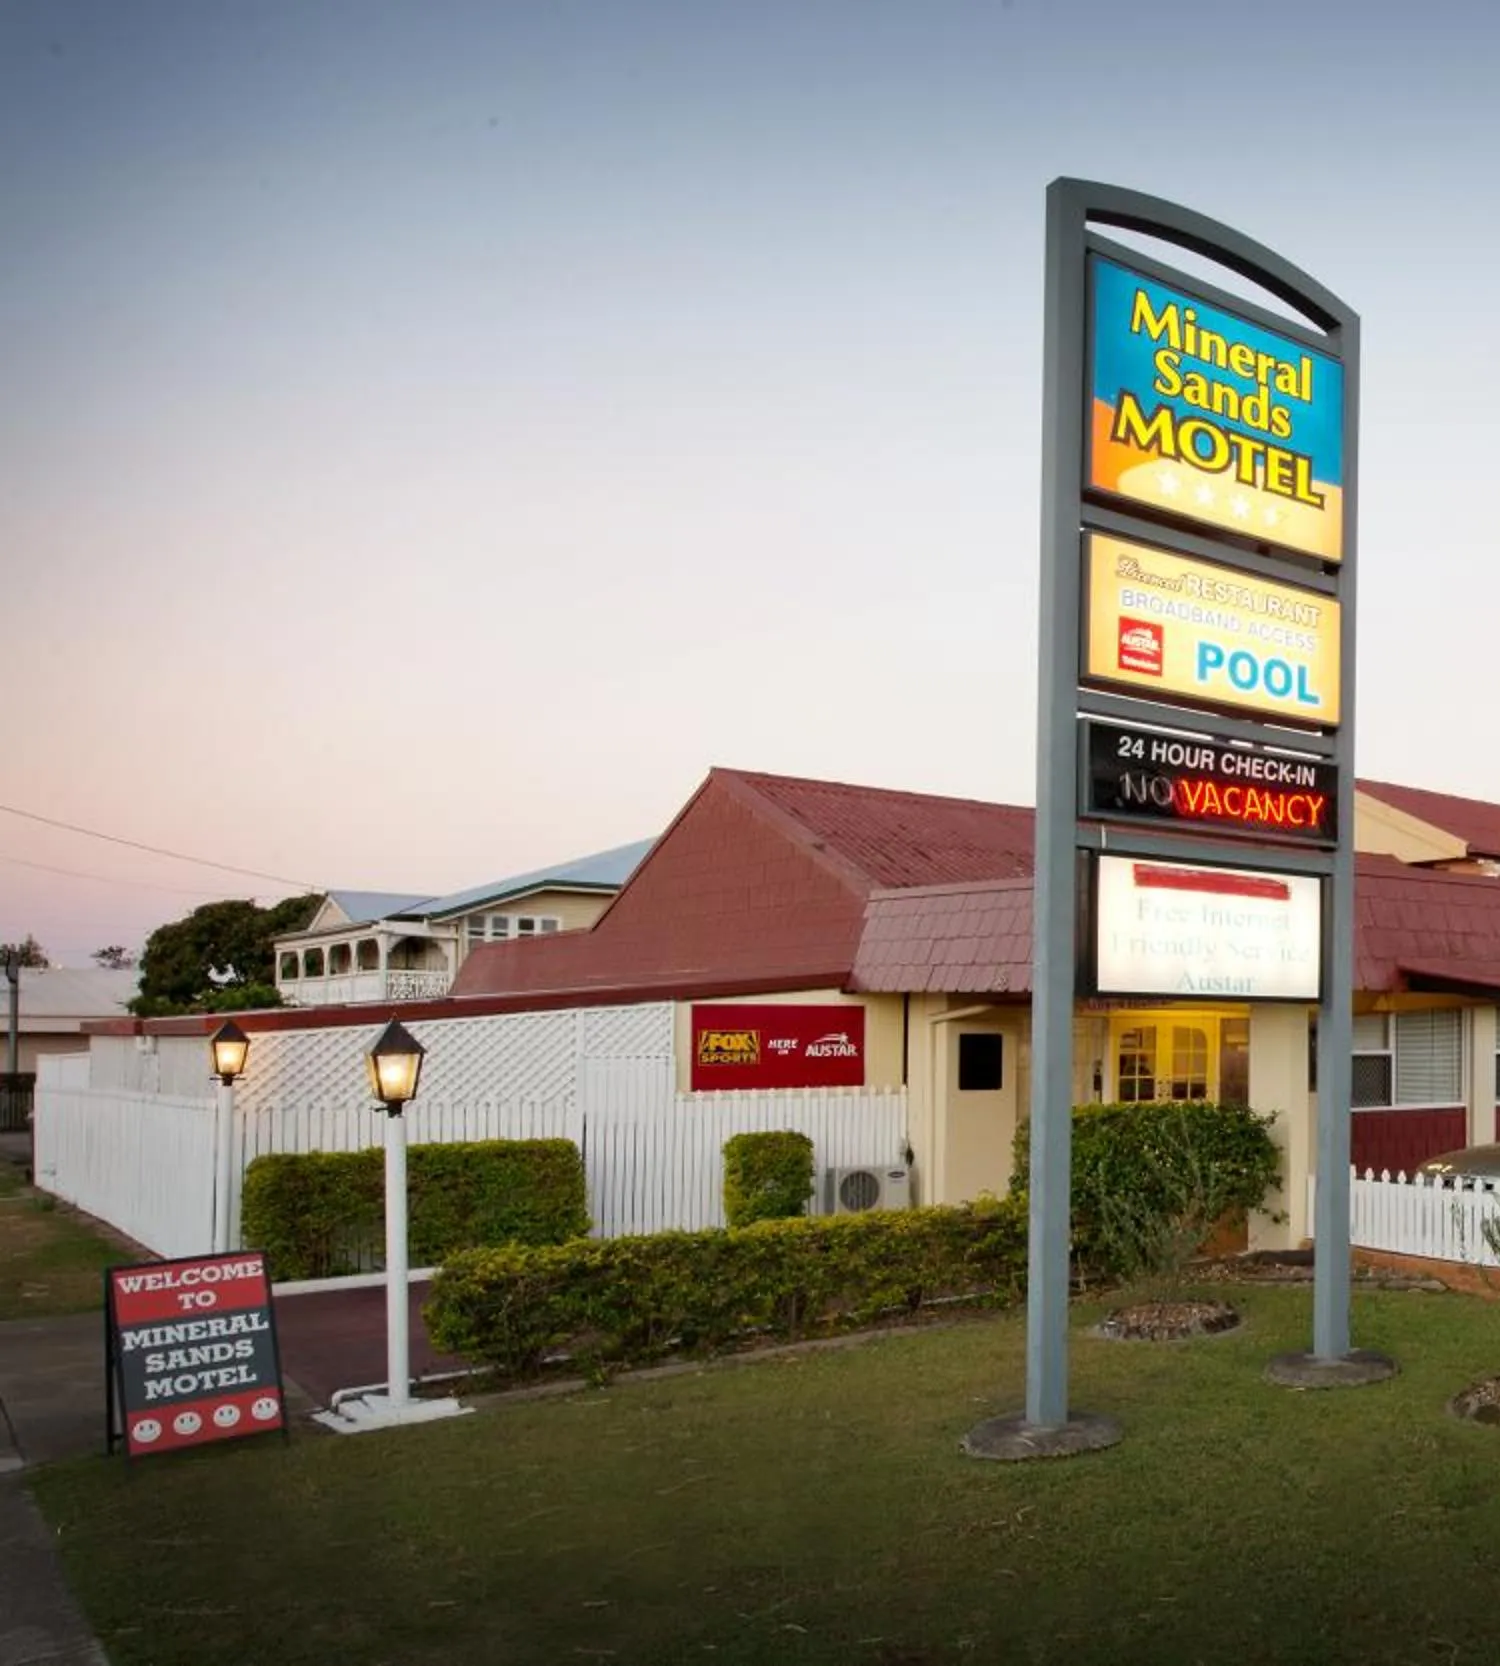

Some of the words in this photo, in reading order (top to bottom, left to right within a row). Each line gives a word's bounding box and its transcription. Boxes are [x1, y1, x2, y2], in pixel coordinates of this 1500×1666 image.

[1130, 288, 1313, 404] Mineral
[1153, 349, 1292, 439] Sands
[1111, 387, 1325, 511] MOTEL
[1182, 573, 1321, 628] RESTAURANT
[1121, 590, 1242, 633] BROADBAND
[1247, 622, 1317, 652] ACCESS
[1196, 641, 1320, 706] POOL
[1118, 736, 1144, 759] 24
[1151, 741, 1214, 771] HOUR
[1221, 752, 1316, 787] CHECK-IN
[1120, 773, 1174, 805] NO
[1180, 778, 1324, 826] VACANCY
[1136, 896, 1191, 923] Free
[1112, 933, 1218, 963] Friendly
[1174, 971, 1256, 993] Austar
[707, 1034, 750, 1050] FOX
[768, 1040, 798, 1049] HERE
[805, 1043, 857, 1057] AUSTAR
[117, 1260, 264, 1294] WELCOME
[178, 1290, 217, 1310] TO
[121, 1312, 270, 1351] MINERAL
[145, 1339, 254, 1374] SANDS
[144, 1364, 257, 1400] MOTEL
